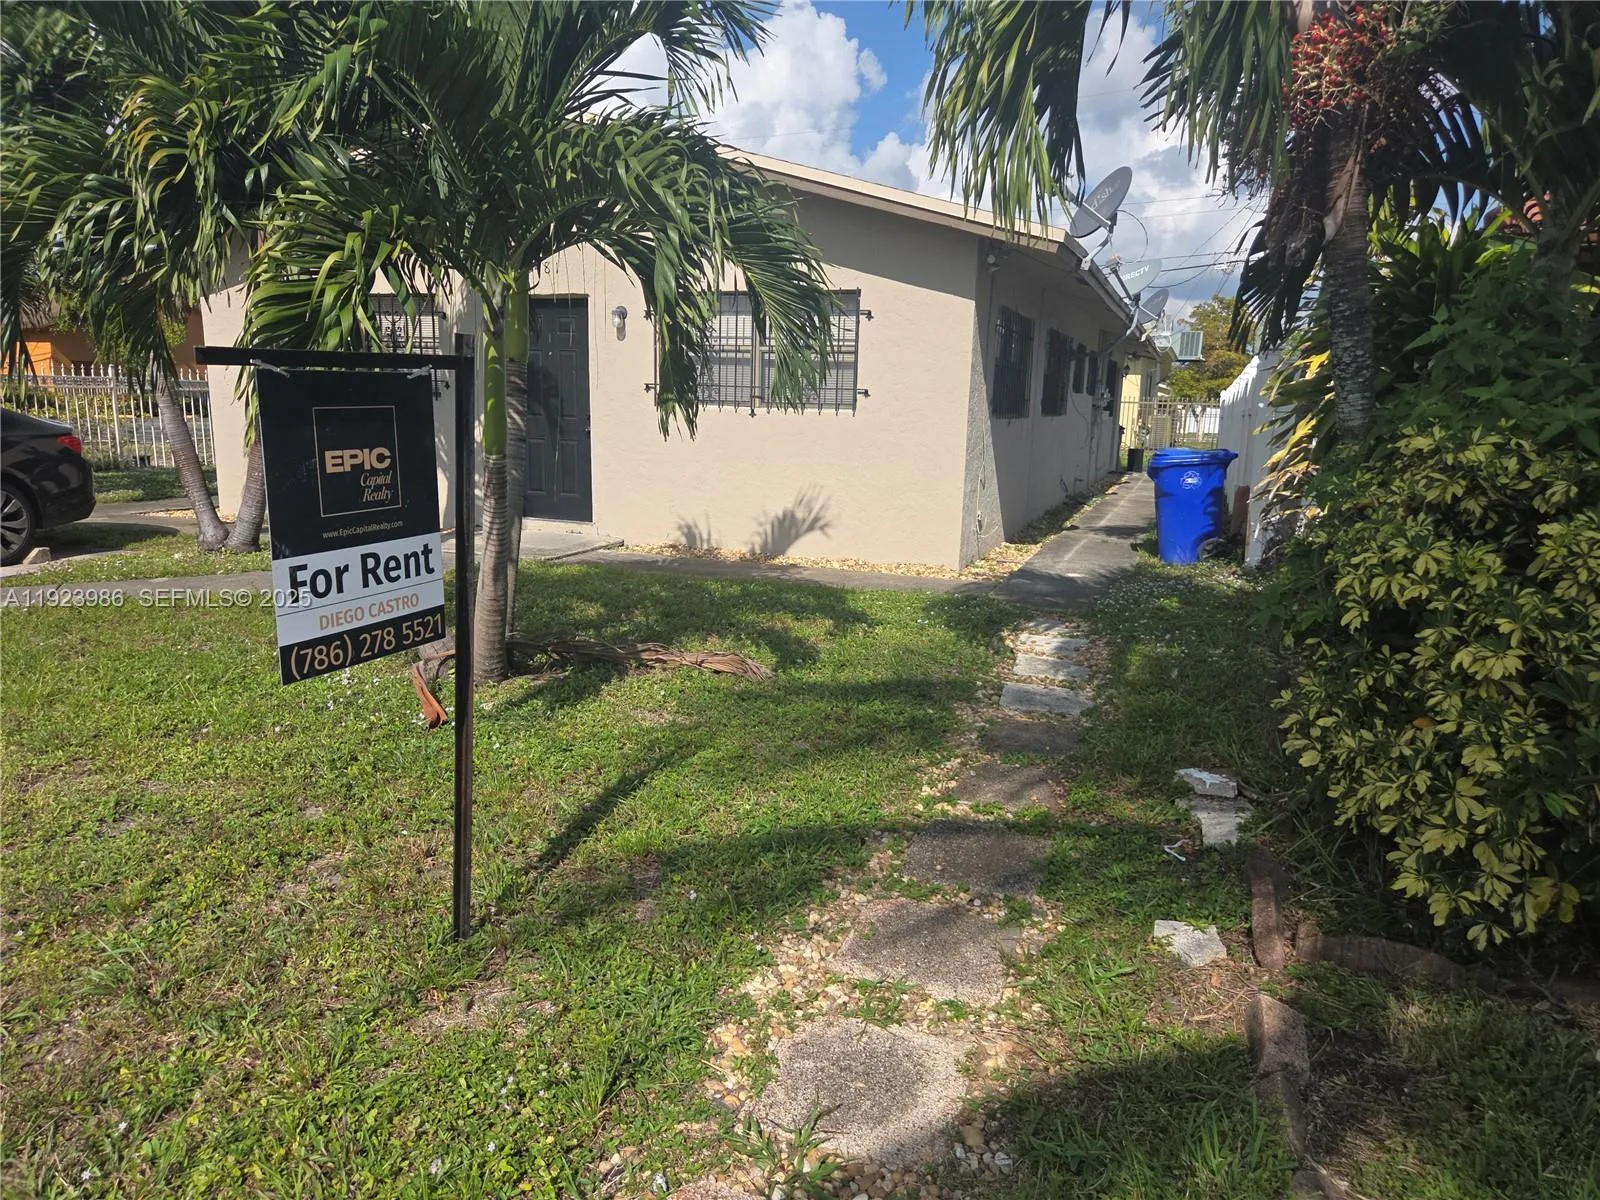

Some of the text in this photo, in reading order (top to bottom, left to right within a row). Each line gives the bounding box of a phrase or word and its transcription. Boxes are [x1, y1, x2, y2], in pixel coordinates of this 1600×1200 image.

[324, 446, 392, 474] EPIC
[360, 470, 392, 488] Capital
[362, 486, 394, 504] Realty
[322, 520, 404, 539] www.EpicCapitalRealty.com
[288, 543, 436, 605] For Rent
[319, 592, 420, 632] DIEGO CASTRO
[290, 612, 443, 680] (786) 278 5521
